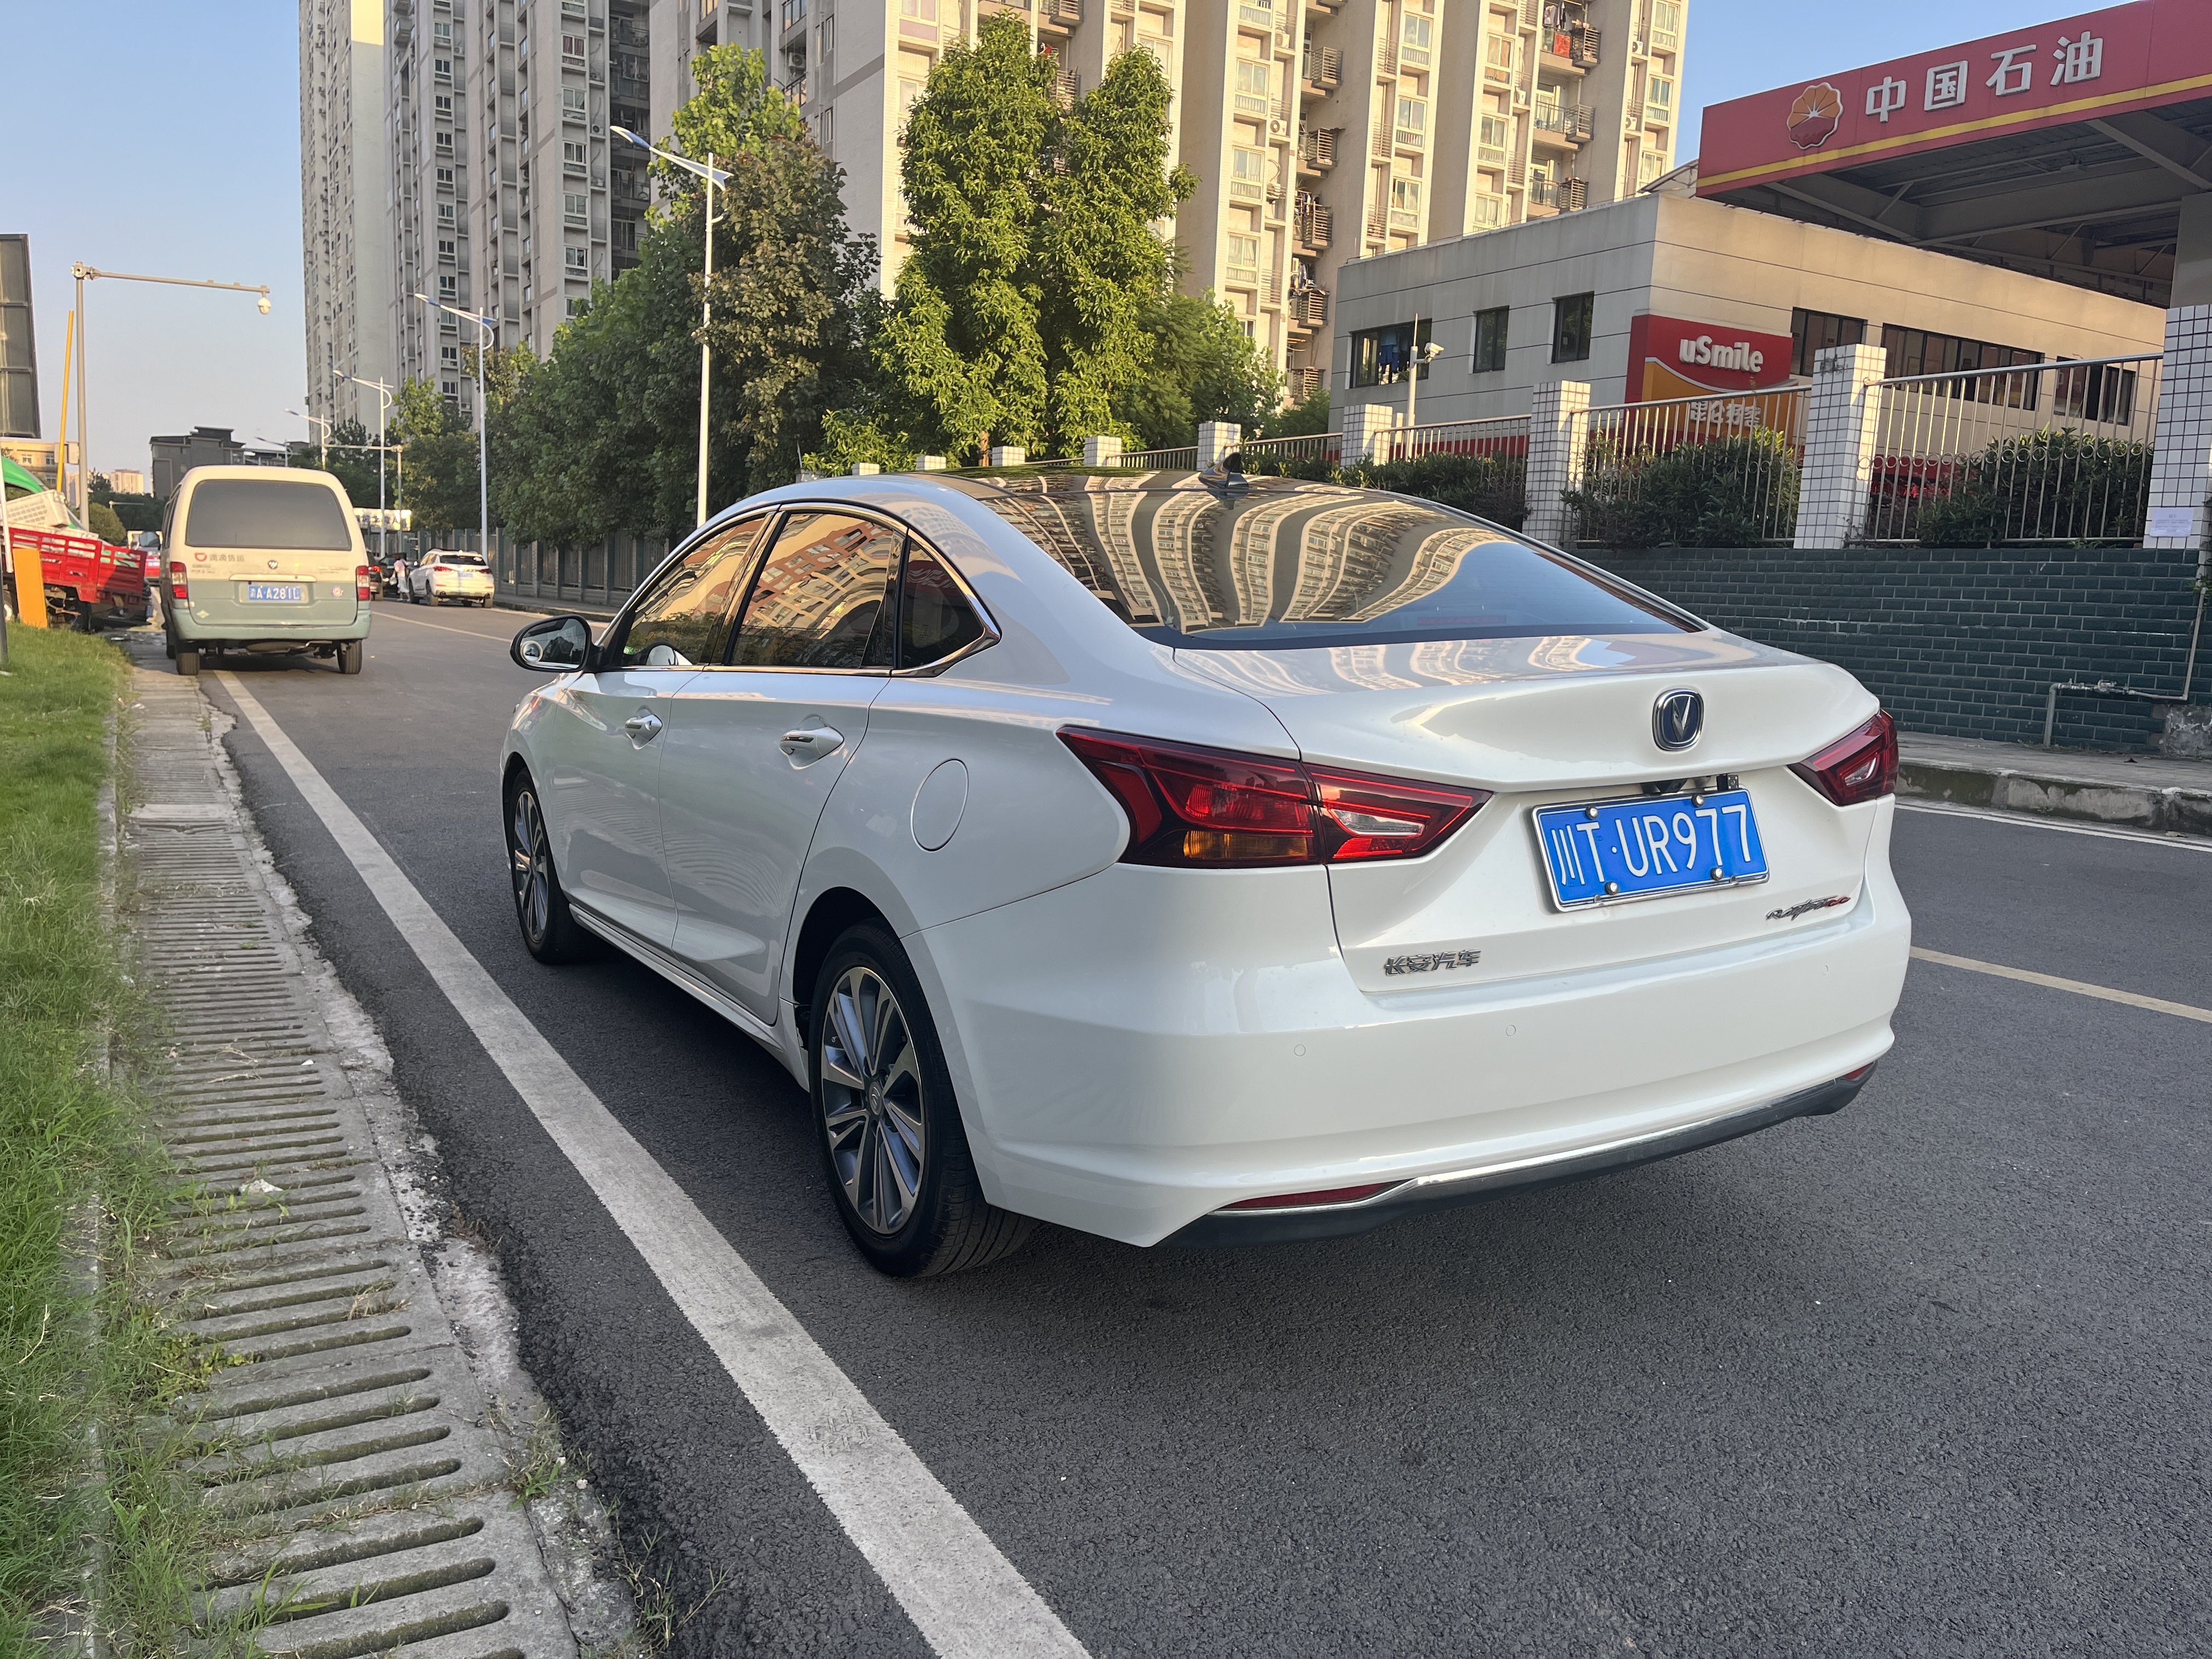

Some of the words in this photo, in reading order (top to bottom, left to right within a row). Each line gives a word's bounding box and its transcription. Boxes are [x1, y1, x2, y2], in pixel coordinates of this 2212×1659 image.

[1865, 31, 2103, 123] 中国石油
[1679, 335, 1763, 373] uSmile
[1690, 400, 1762, 427] 昆仑好客
[1384, 949, 1481, 976] 长安汽车
